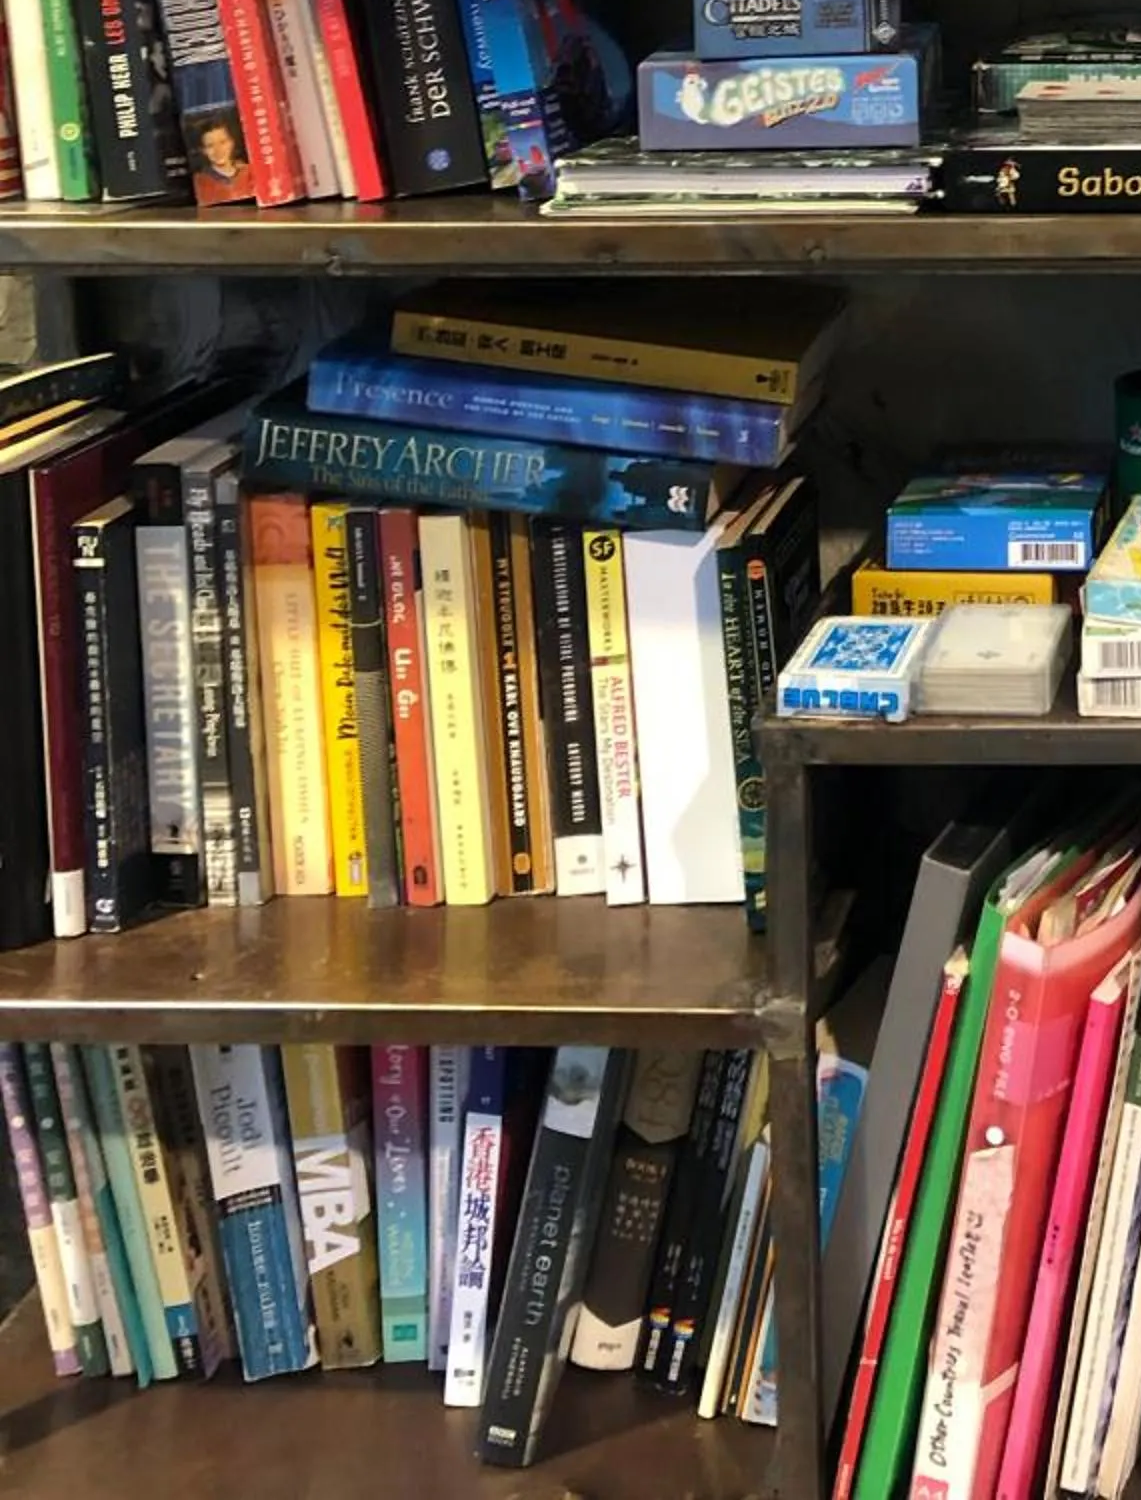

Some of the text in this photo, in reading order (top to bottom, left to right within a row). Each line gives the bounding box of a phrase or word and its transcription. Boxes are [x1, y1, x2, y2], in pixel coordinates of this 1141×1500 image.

[104, 20, 125, 46] LES
[114, 93, 139, 140] PHILIP
[335, 373, 454, 410] Presence
[257, 419, 546, 488] JEFFREY ARCHER
[310, 466, 343, 488] The
[590, 540, 615, 651] SF MASTERWORKS
[144, 541, 191, 813] THE SECRETARY
[726, 615, 745, 685] HEART
[505, 673, 517, 707] KARL
[598, 678, 609, 700] The
[508, 711, 519, 734] OVE
[610, 676, 633, 799] ALFRED BESTER
[735, 725, 751, 764] SEA
[211, 1085, 243, 1175] Picoult
[237, 1098, 264, 1151] Jodi
[294, 1136, 366, 1274] MBA
[458, 1126, 495, 1291] 香港城邦論
[527, 1165, 569, 1328] planet earth
[930, 1409, 954, 1468] Other
